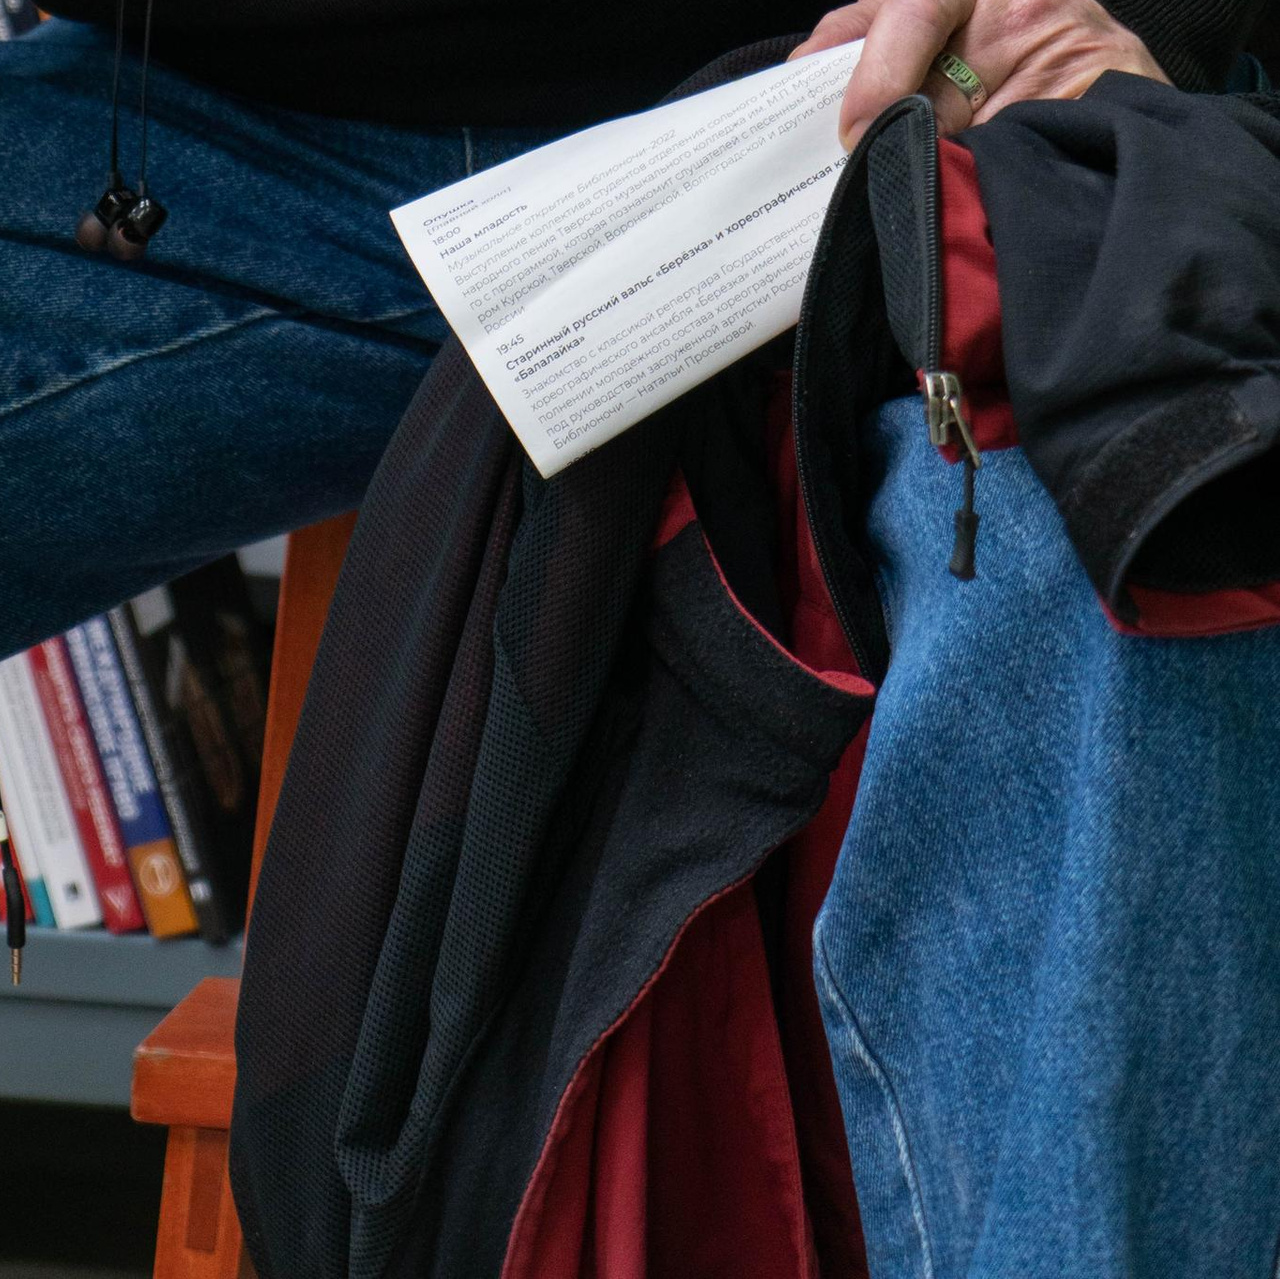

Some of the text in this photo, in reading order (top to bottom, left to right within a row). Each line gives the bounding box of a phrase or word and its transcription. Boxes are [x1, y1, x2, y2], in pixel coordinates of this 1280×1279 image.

[422, 199, 473, 226] Опушка
[432, 226, 460, 245] 18:00
[439, 204, 527, 259] Наша младость
[447, 223, 522, 273] Музыкальное
[523, 190, 575, 226] открытие
[453, 59, 820, 286] Выступление коллектива студентов отделения сольного и хорового
[461, 257, 520, 297] народного
[521, 234, 556, 260] пения
[555, 199, 613, 236] Тверского
[613, 150, 691, 202] музыкального
[692, 116, 746, 153] колледжа
[469, 298, 482, 310] го
[482, 292, 491, 301] с
[491, 248, 564, 296] программой,
[563, 219, 607, 250] которая
[607, 176, 673, 222] познакомит
[674, 135, 740, 180] слушателей
[740, 130, 749, 139] с
[748, 95, 806, 134] песенным
[477, 303, 500, 324] ром
[500, 273, 551, 307] Курской,
[548, 238, 605, 275] Тверской,
[681, 135, 766, 192] Волгоградской
[767, 130, 775, 139] и
[777, 106, 815, 135] других
[505, 325, 570, 370] Старинный
[571, 295, 619, 331] русский
[620, 275, 653, 299] вальс
[655, 238, 713, 276] «Берёзка»
[714, 231, 724, 240] и
[724, 165, 832, 234] хореографическая
[521, 211, 819, 399] Знакомство с классикой репертуара Государственного
[530, 340, 638, 412] хореографического
[639, 306, 693, 344] ансамбля
[750, 247, 788, 274] имени
[495, 333, 524, 355] 19:45
[514, 336, 584, 382] «Балалайка»
[537, 385, 594, 424] полнении
[671, 311, 714, 341] состава
[545, 419, 570, 436] под
[568, 370, 646, 425] руководством
[646, 323, 719, 374] заслуженной
[720, 293, 771, 328] артистки
[552, 320, 756, 449] Библионочи Натальи Просековой.
